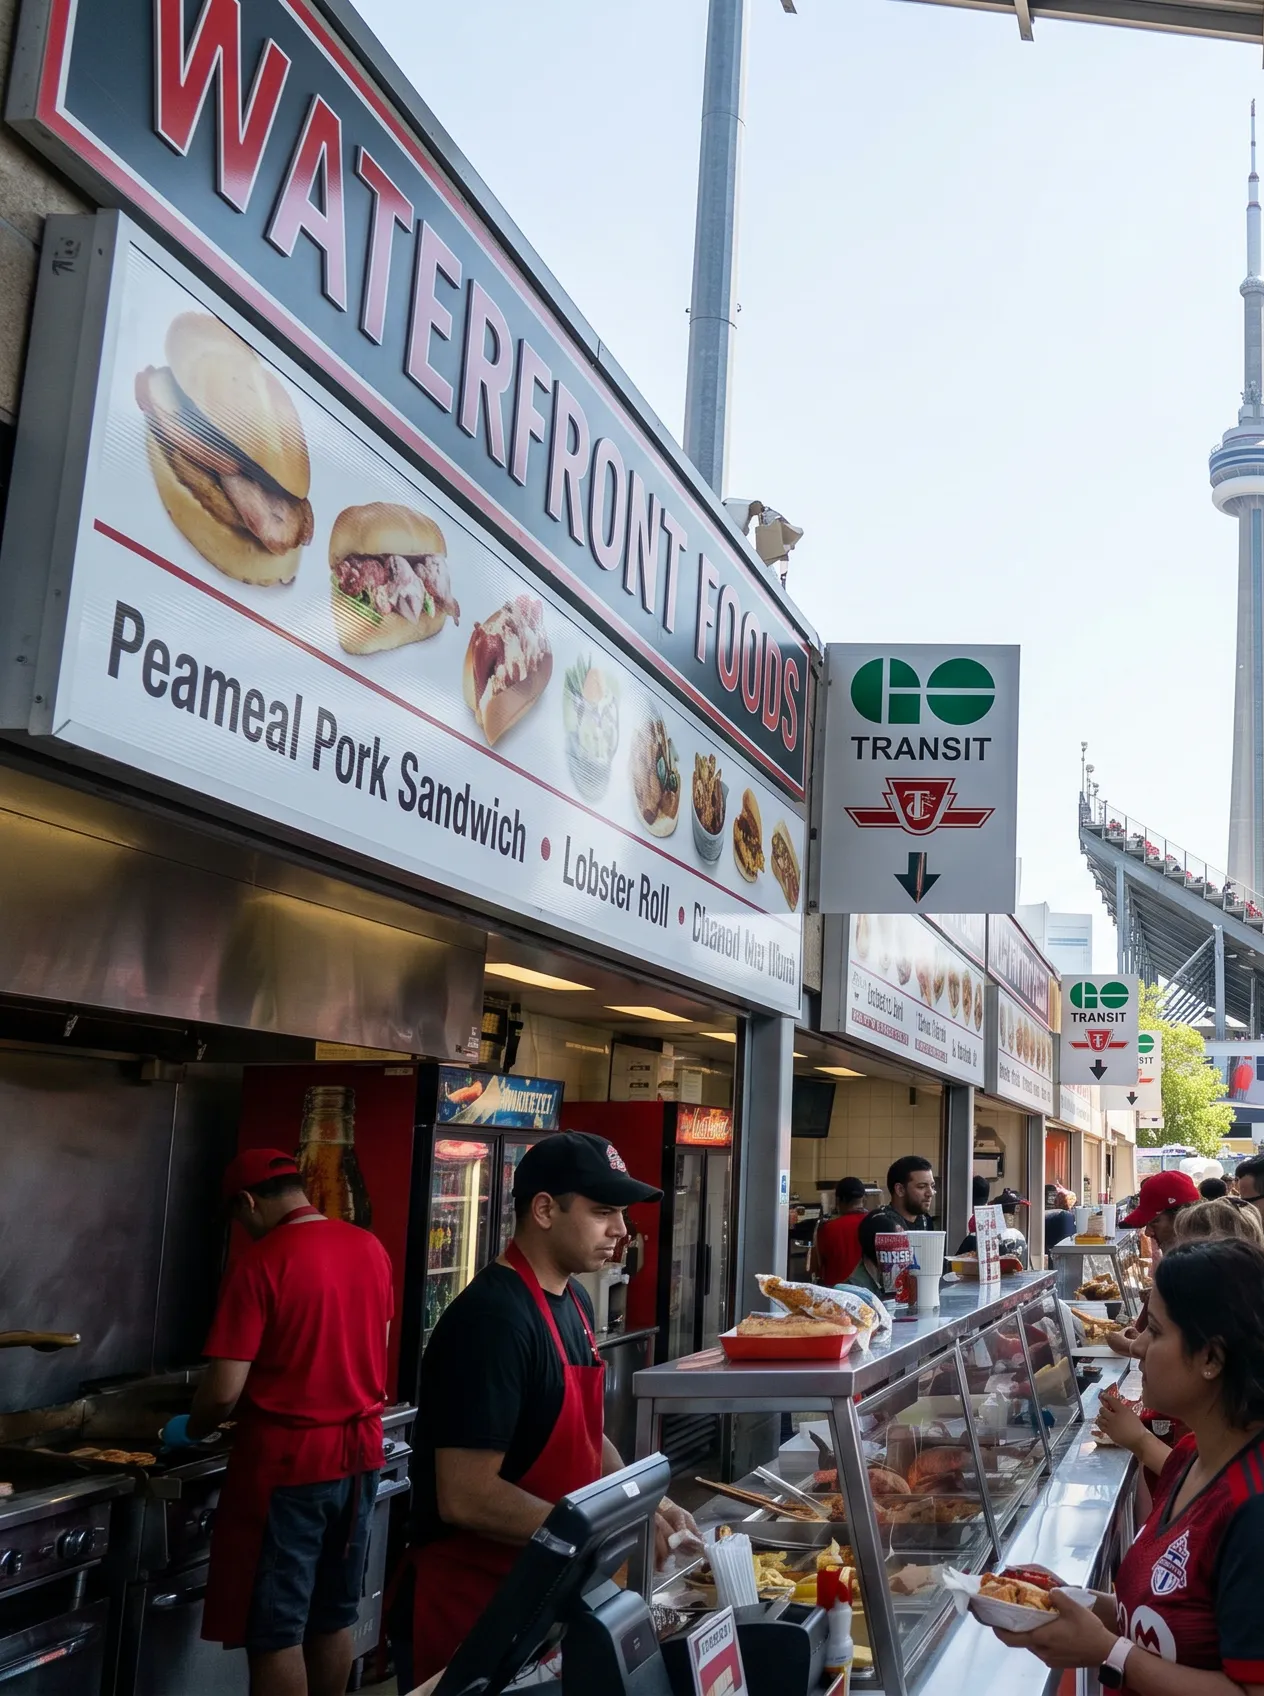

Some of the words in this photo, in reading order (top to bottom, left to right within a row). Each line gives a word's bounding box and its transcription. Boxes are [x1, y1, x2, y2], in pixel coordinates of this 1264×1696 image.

[152, 0, 688, 634] WATERFRONT
[694, 551, 801, 752] FOODS
[107, 600, 303, 760] Peameal
[312, 706, 389, 801] Pork
[397, 751, 527, 863] Sandwich
[562, 835, 634, 912] Lobster
[638, 872, 670, 929] Roll
[850, 736, 992, 761] TRANSIT
[1070, 1012, 1127, 1023] TRANSIT
